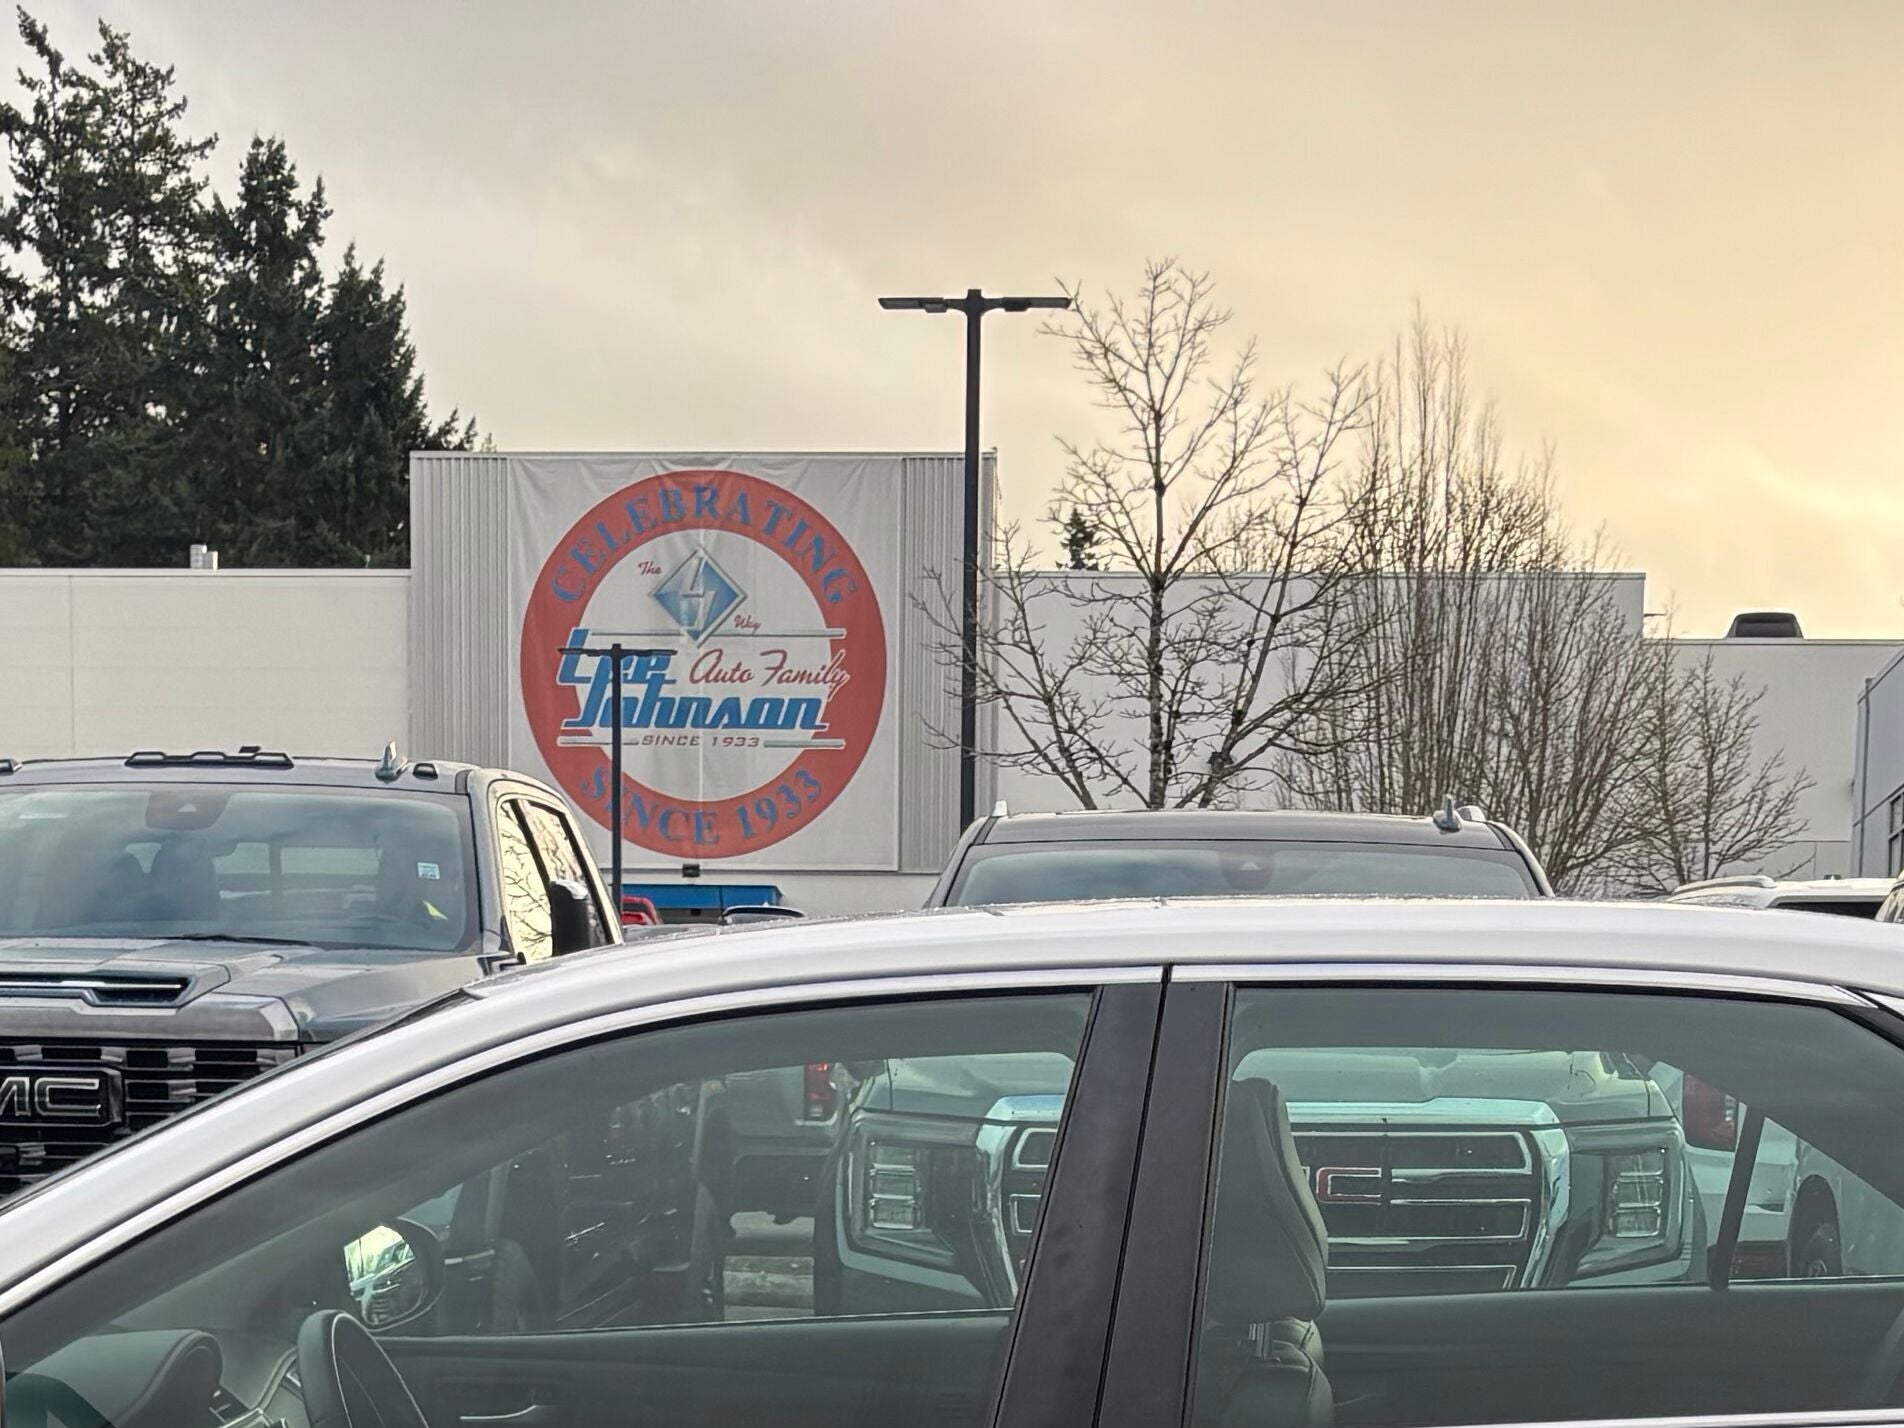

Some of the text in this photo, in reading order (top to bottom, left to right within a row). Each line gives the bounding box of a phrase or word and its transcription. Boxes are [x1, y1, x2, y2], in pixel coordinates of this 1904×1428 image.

[550, 484, 858, 605] CELEBRATING
[638, 560, 663, 577] The
[563, 671, 829, 730] Johnson
[689, 648, 754, 686] Auto
[759, 648, 851, 702] Family
[641, 734, 761, 749] SINCE 1933
[735, 767, 823, 840] 1933
